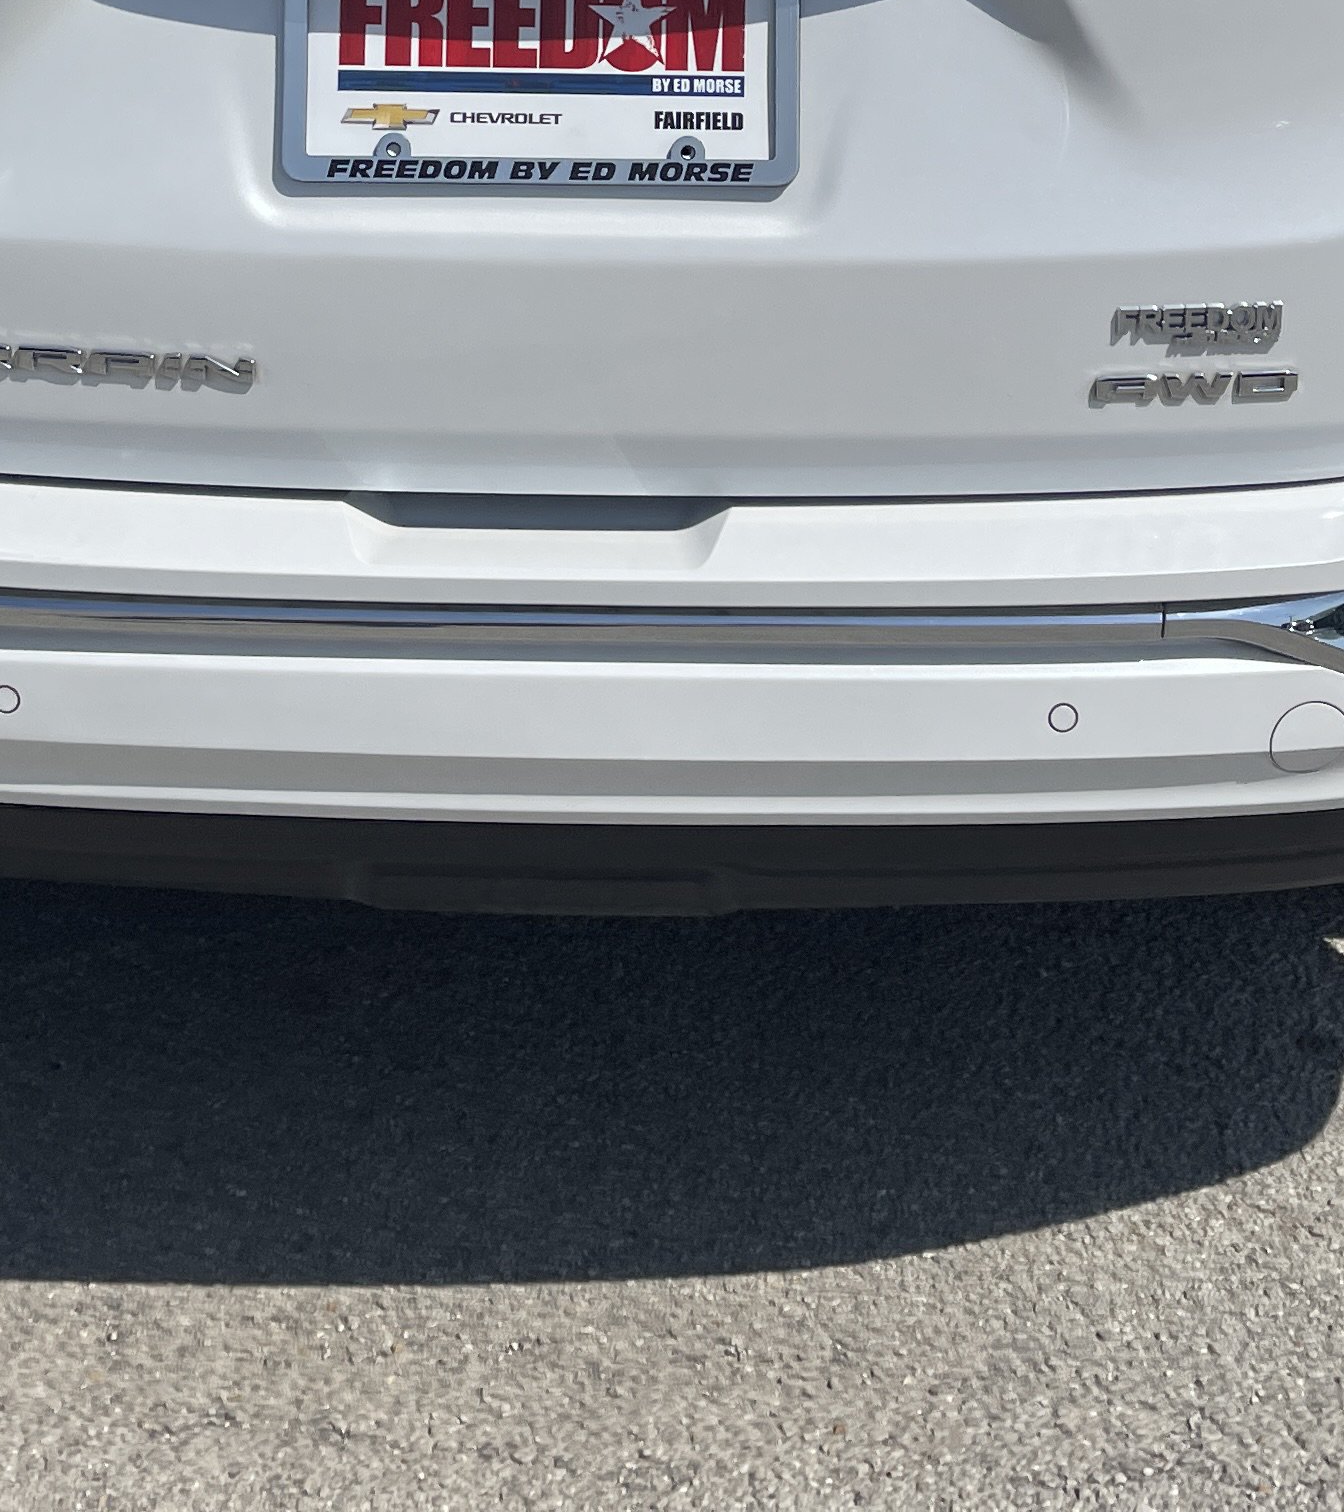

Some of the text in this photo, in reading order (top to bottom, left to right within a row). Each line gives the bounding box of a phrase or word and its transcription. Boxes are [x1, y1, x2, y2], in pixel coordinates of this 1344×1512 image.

[651, 77, 742, 95] BY ED MORSE
[449, 111, 563, 125] CHEVROLET
[654, 110, 744, 131] FAIRFIELD
[326, 159, 753, 183] FREEDOM BY ED MORSE
[1113, 301, 1284, 336] FREEDOM
[1090, 370, 1299, 405] AWD
